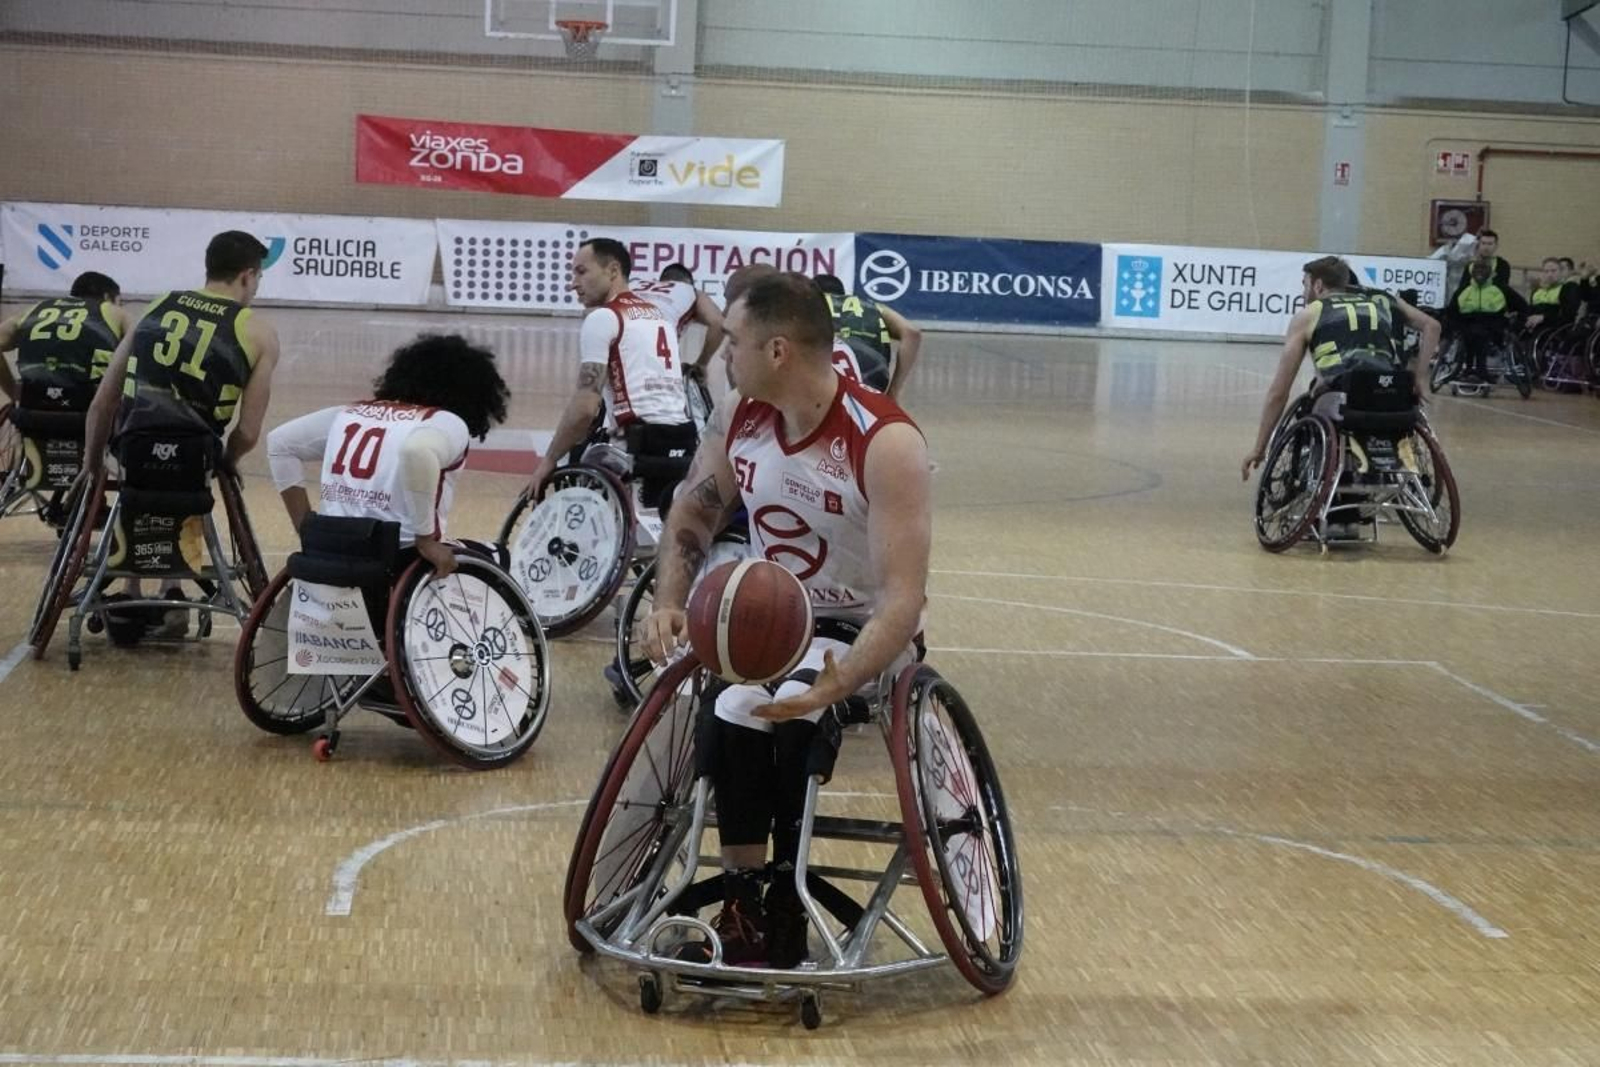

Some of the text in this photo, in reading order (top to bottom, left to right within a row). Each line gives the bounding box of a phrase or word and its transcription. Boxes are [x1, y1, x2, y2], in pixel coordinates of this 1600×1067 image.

[409, 130, 489, 153] viaxes
[79, 224, 150, 239] DEPORTE
[79, 239, 143, 253] GALEGO
[293, 237, 376, 258] GALICIA
[629, 238, 835, 276] EPUTACIÓN
[292, 257, 402, 280] SAUDABLE
[1171, 262, 1257, 287] XUNTA
[918, 269, 1094, 300] IBERCONSA
[177, 295, 229, 317] CUSACK
[1169, 287, 1306, 316] DE GALICIA
[29, 308, 89, 341] 23
[1332, 302, 1379, 332] 77
[152, 310, 218, 381] 31
[656, 326, 673, 370] 4
[331, 422, 387, 480] 10
[734, 456, 757, 494] 51
